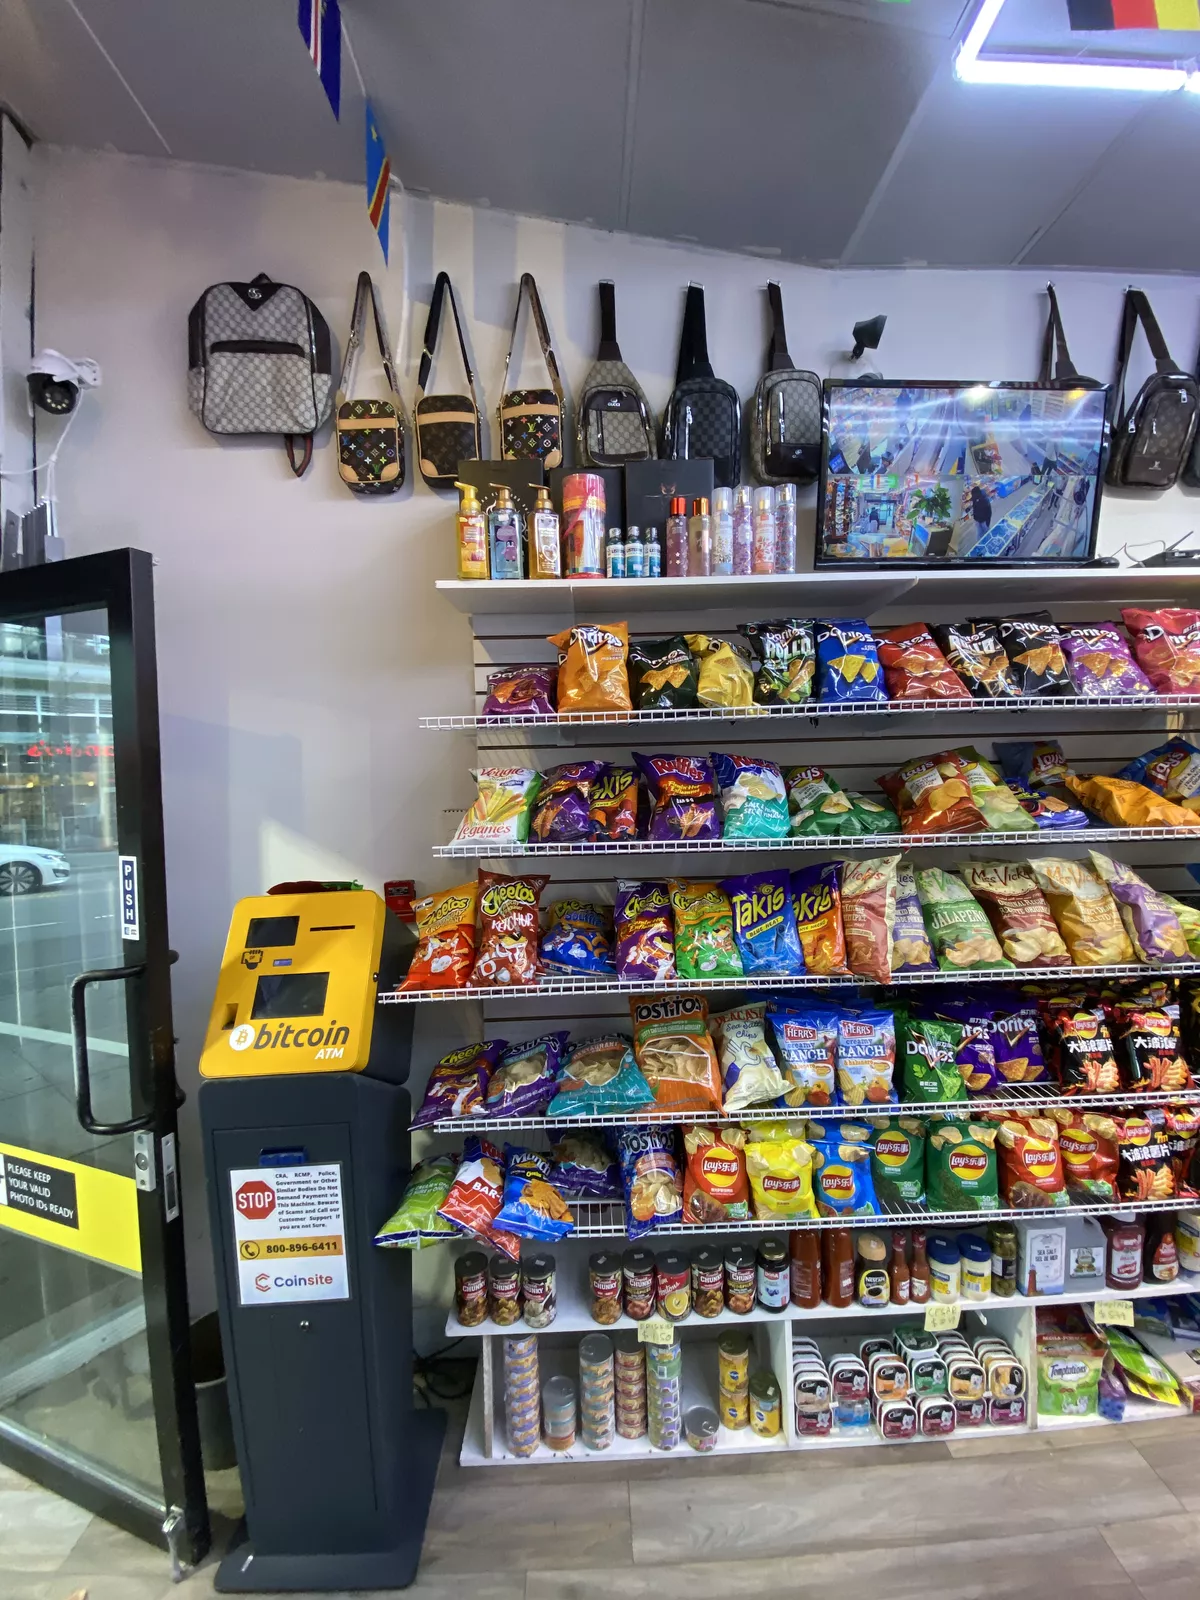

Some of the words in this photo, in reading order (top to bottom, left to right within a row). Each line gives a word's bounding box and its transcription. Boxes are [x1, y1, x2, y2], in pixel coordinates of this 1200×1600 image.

[1000, 622, 1060, 638] Doritos
[1059, 629, 1121, 642] Doritos
[650, 757, 706, 782] Ruffles
[902, 760, 935, 781] Lay's
[1151, 752, 1185, 782] Lay's
[971, 867, 996, 887] Miss
[124, 864, 134, 921] PUSH
[481, 880, 537, 917] Cheetos
[623, 888, 670, 919] Cheetos
[732, 887, 785, 934] Takis
[418, 896, 472, 929] Cheetos
[931, 906, 987, 929] JALAPEÑO
[492, 912, 534, 933] KETCHUP
[749, 926, 764, 938] BLUE
[765, 918, 780, 929] HEAT
[253, 1019, 350, 1049] bitcoin
[726, 1021, 741, 1033] Sea
[786, 1027, 814, 1039] HERR'S
[844, 1023, 871, 1035] HERR'S
[735, 1030, 758, 1040] Chips
[845, 1038, 873, 1046] creamy
[314, 1047, 345, 1060] ATM
[787, 1042, 815, 1051] creamy
[838, 1045, 886, 1057] RANCH
[907, 1041, 954, 1063] Doritos
[1067, 1039, 1115, 1053] 大波浪薯片
[783, 1048, 828, 1061] RANCH
[1120, 1144, 1171, 1162] 大波浪薯片
[7, 1162, 33, 1179] PLEASE
[33, 1170, 52, 1183] KEEP
[8, 1177, 29, 1191] YOUR
[29, 1183, 51, 1198] VALID
[238, 1191, 273, 1209] STOP
[302, 1193, 328, 1201] Payment
[10, 1191, 35, 1207] PHOTO
[35, 1199, 48, 1211] IDs
[49, 1203, 74, 1219] READY
[266, 1242, 337, 1254] 800-896-6411
[274, 1274, 333, 1288] Coinsite
[629, 1278, 653, 1288] CHUNKY
[700, 1273, 723, 1283] CHUNKY
[731, 1272, 755, 1282] CHUNKY
[462, 1280, 486, 1293] CHUNKY
[492, 1283, 517, 1291] CHUNKY
[593, 1280, 617, 1290] CHUNKY
[928, 1306, 957, 1318] CESAR
[1050, 1363, 1087, 1379] Temptations
